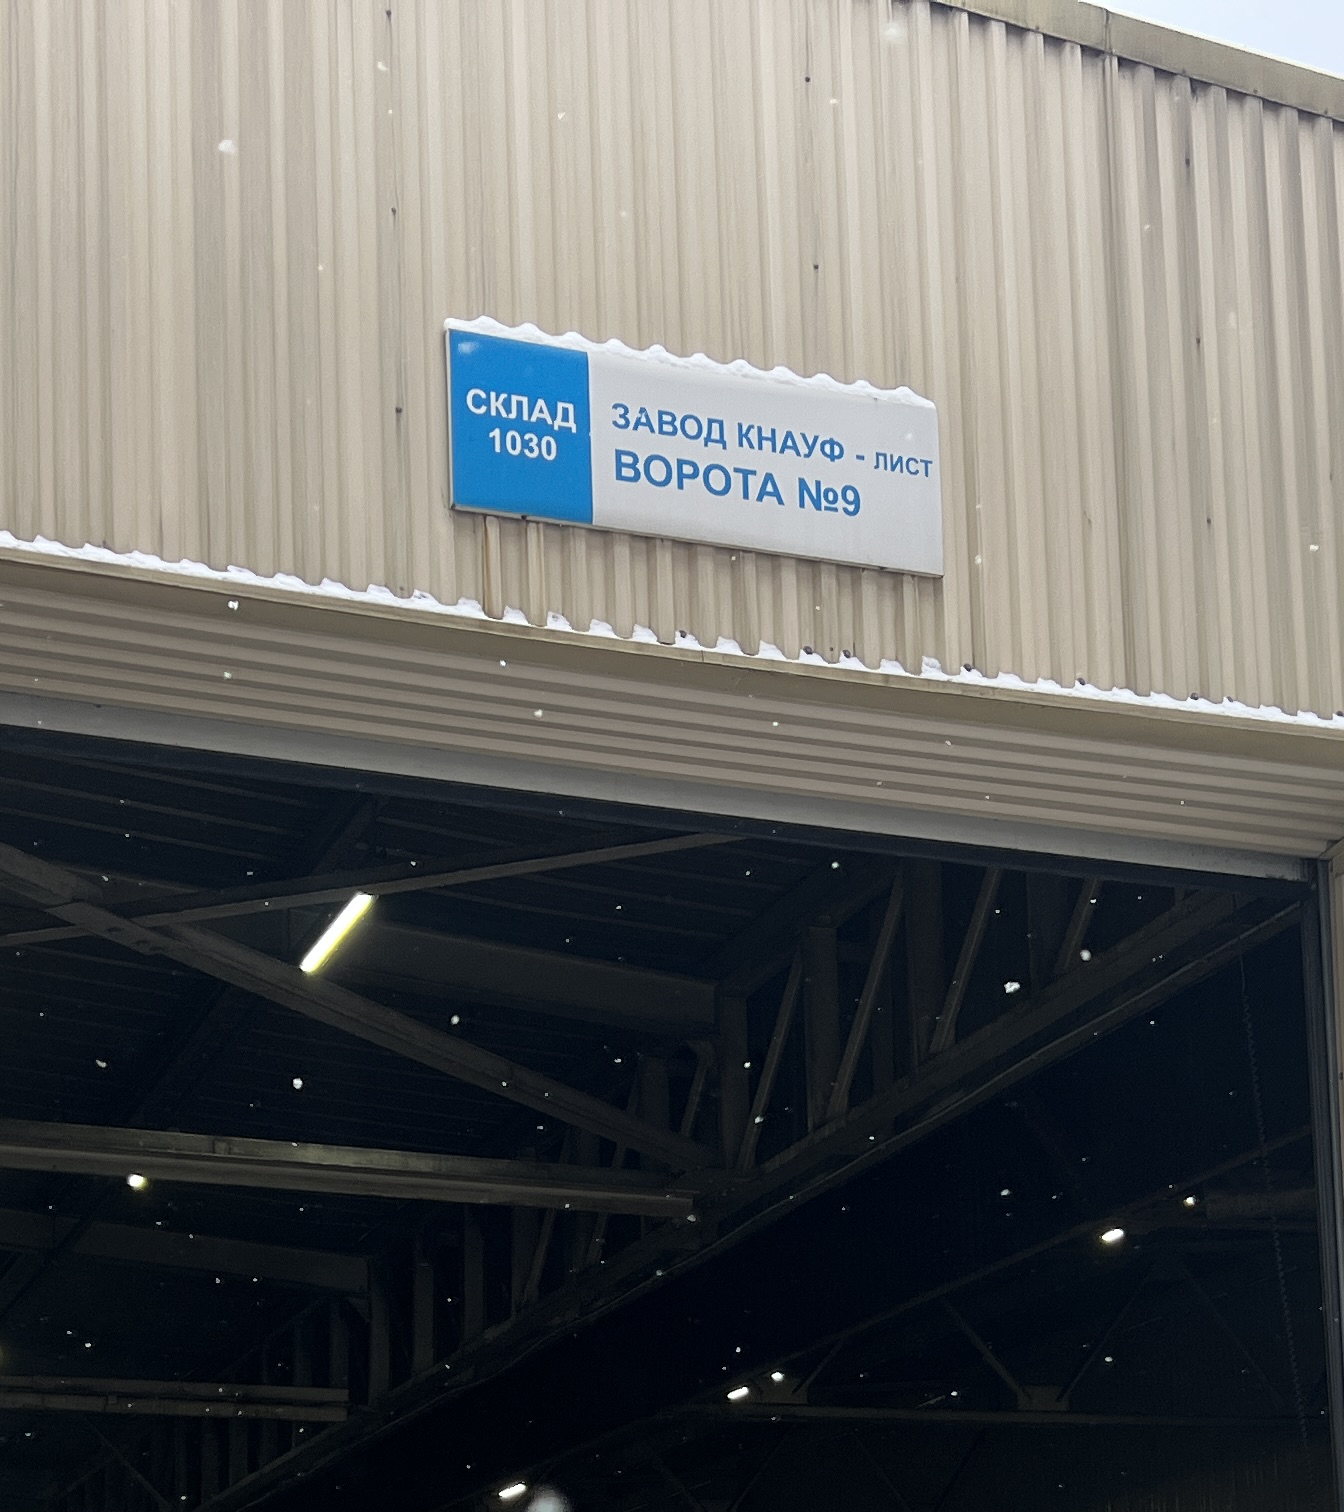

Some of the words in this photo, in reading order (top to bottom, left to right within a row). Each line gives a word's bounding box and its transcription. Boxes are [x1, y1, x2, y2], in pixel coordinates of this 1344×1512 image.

[465, 387, 577, 433] СКЛАД
[611, 402, 727, 451] ЗАВОД
[737, 422, 845, 463] КНАУФ
[488, 428, 557, 461] 1030
[614, 448, 785, 506] ВОРОТА
[798, 477, 861, 517] №9
